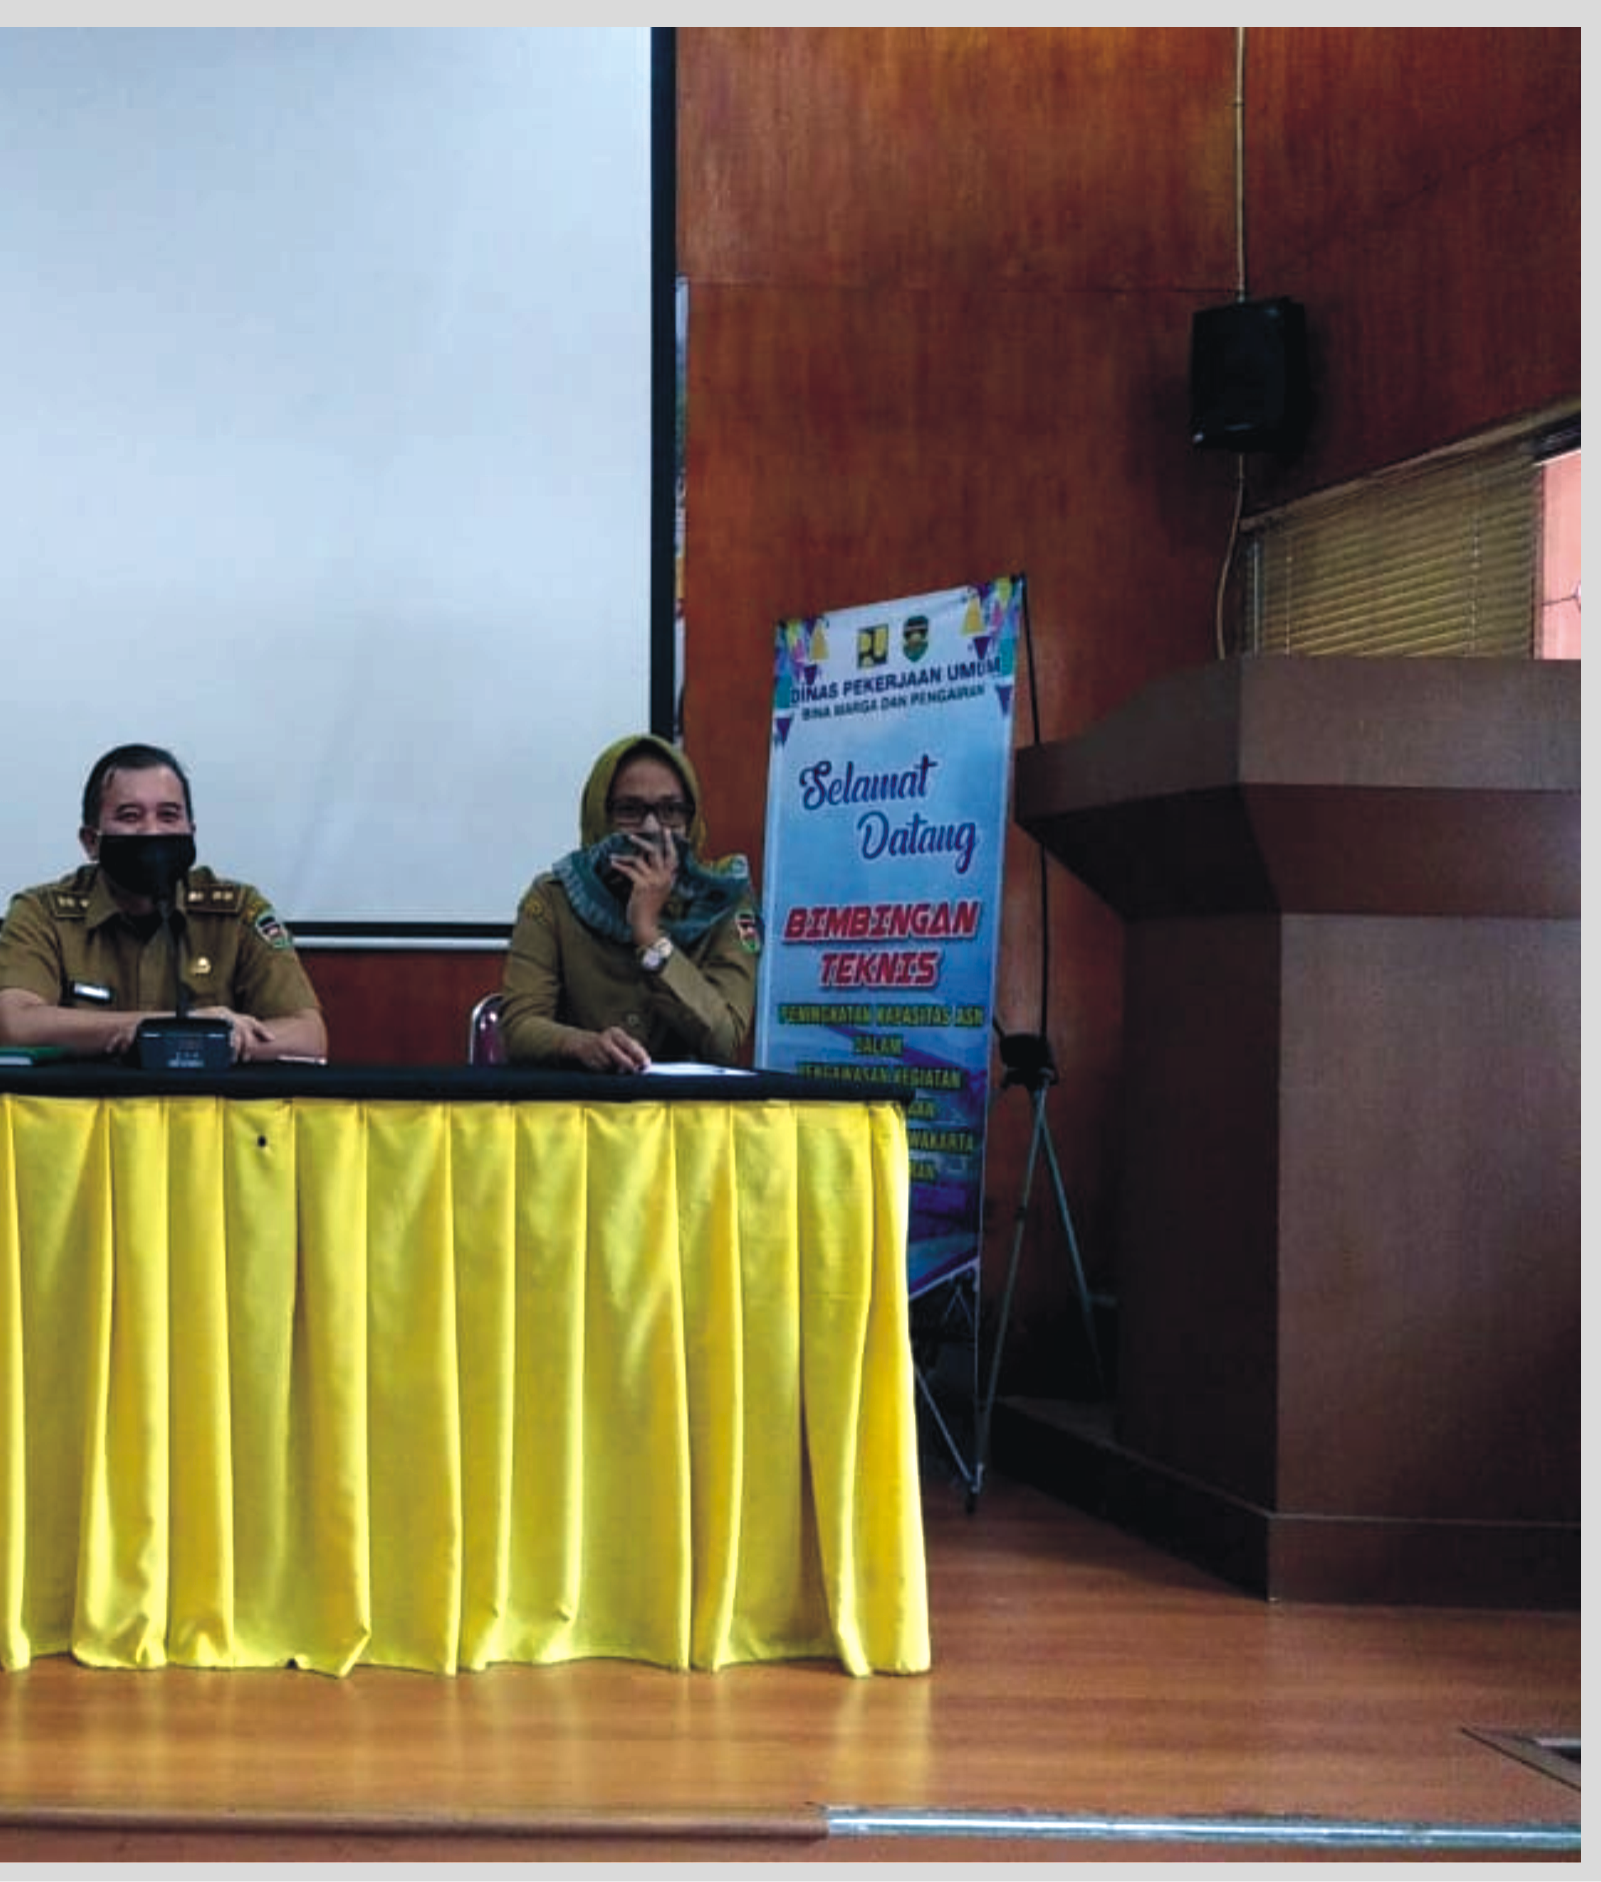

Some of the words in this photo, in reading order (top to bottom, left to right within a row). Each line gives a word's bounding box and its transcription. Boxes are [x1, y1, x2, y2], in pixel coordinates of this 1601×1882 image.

[791, 681, 837, 703] DINAS
[843, 669, 941, 697] PEKERJAAN
[947, 656, 1000, 681] UMUM
[802, 704, 830, 720] BINA
[834, 699, 877, 717] MARGA
[881, 696, 907, 711] DAN
[911, 684, 985, 706] PENGAIRAN
[800, 754, 937, 810] Selamat
[857, 811, 975, 874] Datang
[784, 901, 979, 938] BIMBINGAN
[820, 951, 938, 985] TEKNIS
[780, 1004, 871, 1024] PENINGKATAN
[877, 1005, 949, 1026] KAPASITAS
[854, 1035, 903, 1056] DALAM
